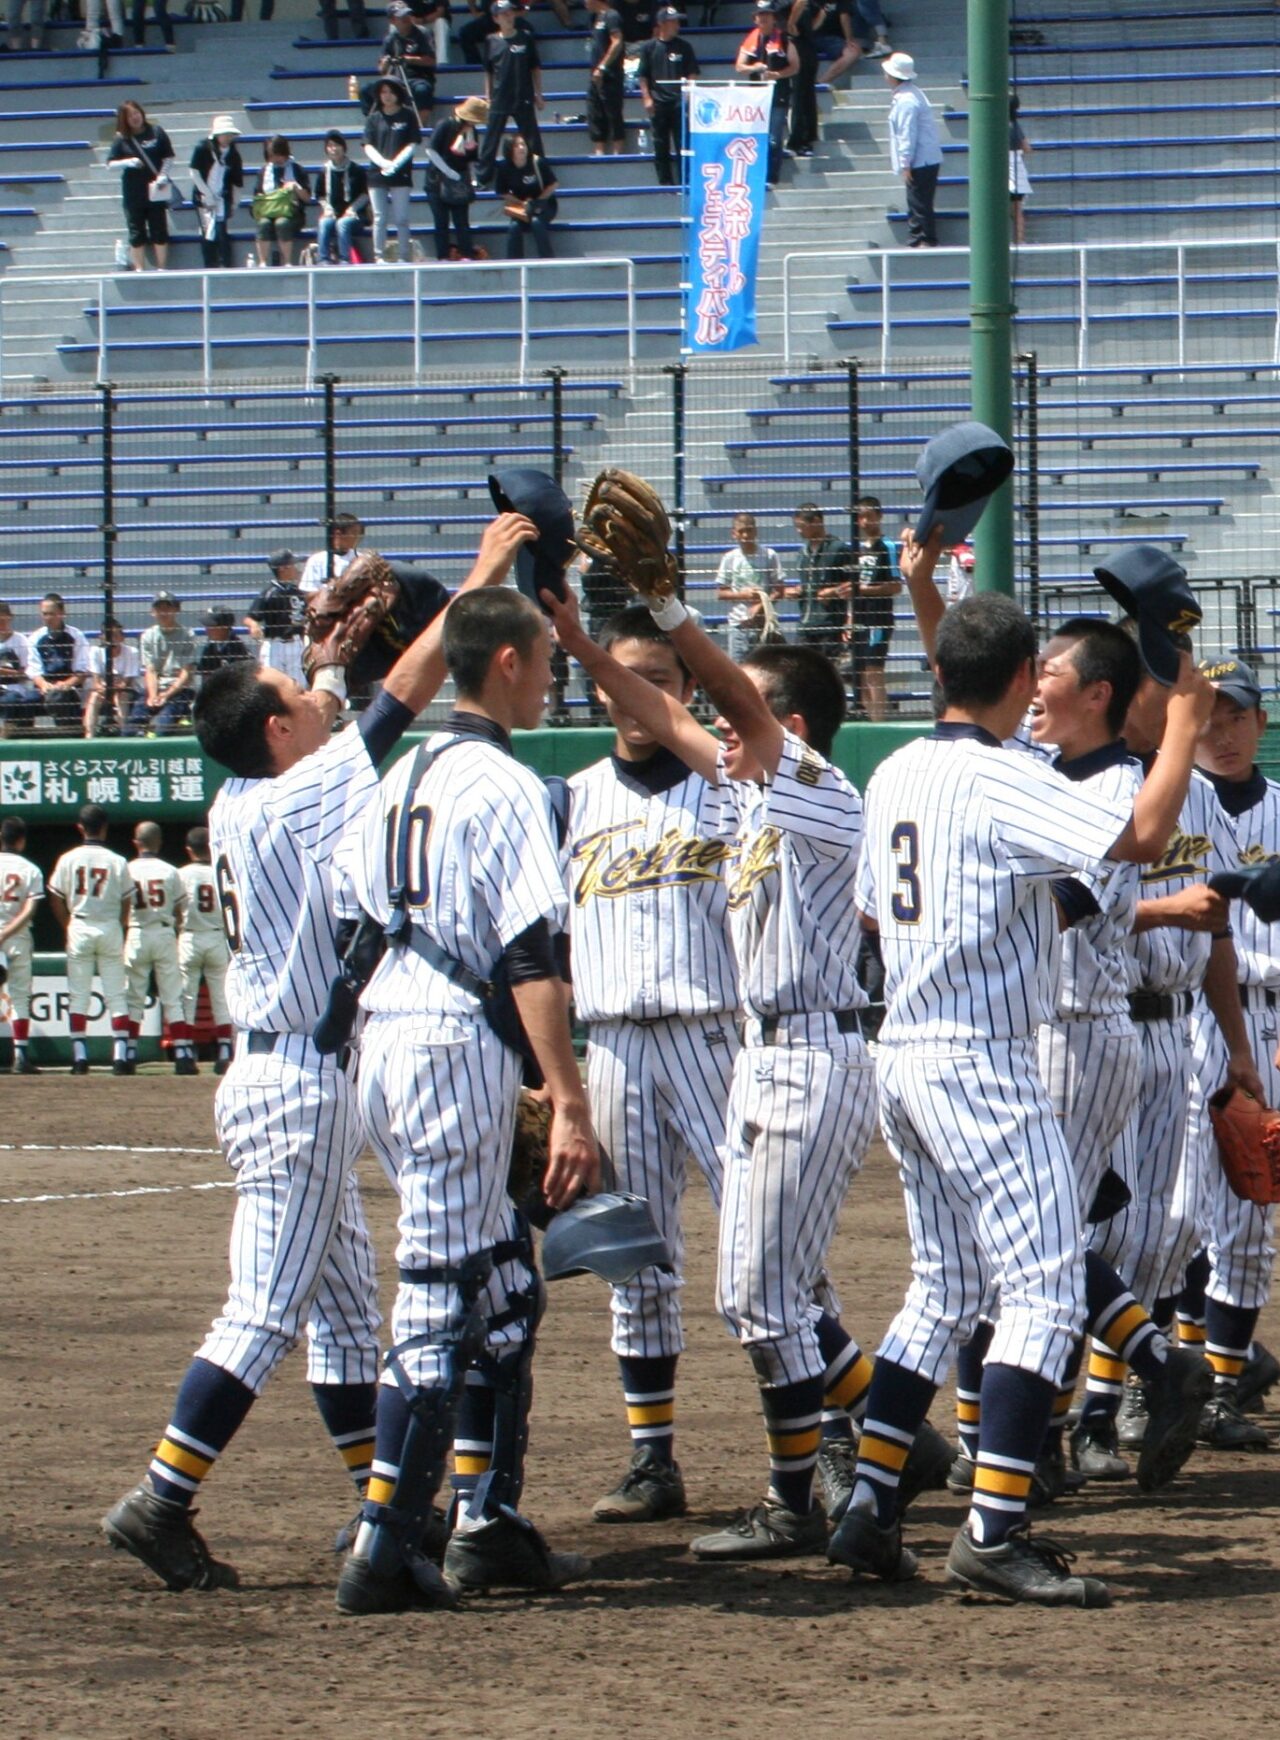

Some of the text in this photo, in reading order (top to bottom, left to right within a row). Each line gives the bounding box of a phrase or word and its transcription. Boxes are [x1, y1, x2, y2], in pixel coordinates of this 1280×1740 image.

[725, 105, 765, 122] JABA
[724, 137, 758, 293] ベースボール
[695, 163, 729, 345] フェスティバル
[44, 758, 203, 776] さくらスマイル引越隊
[44, 776, 205, 804] 札幌通運
[75, 865, 108, 898] 17
[385, 804, 435, 909] 10
[571, 818, 739, 908] Teine
[891, 820, 923, 926] 3
[134, 879, 165, 910] 15
[198, 884, 214, 913] 9
[216, 853, 242, 953] 6
